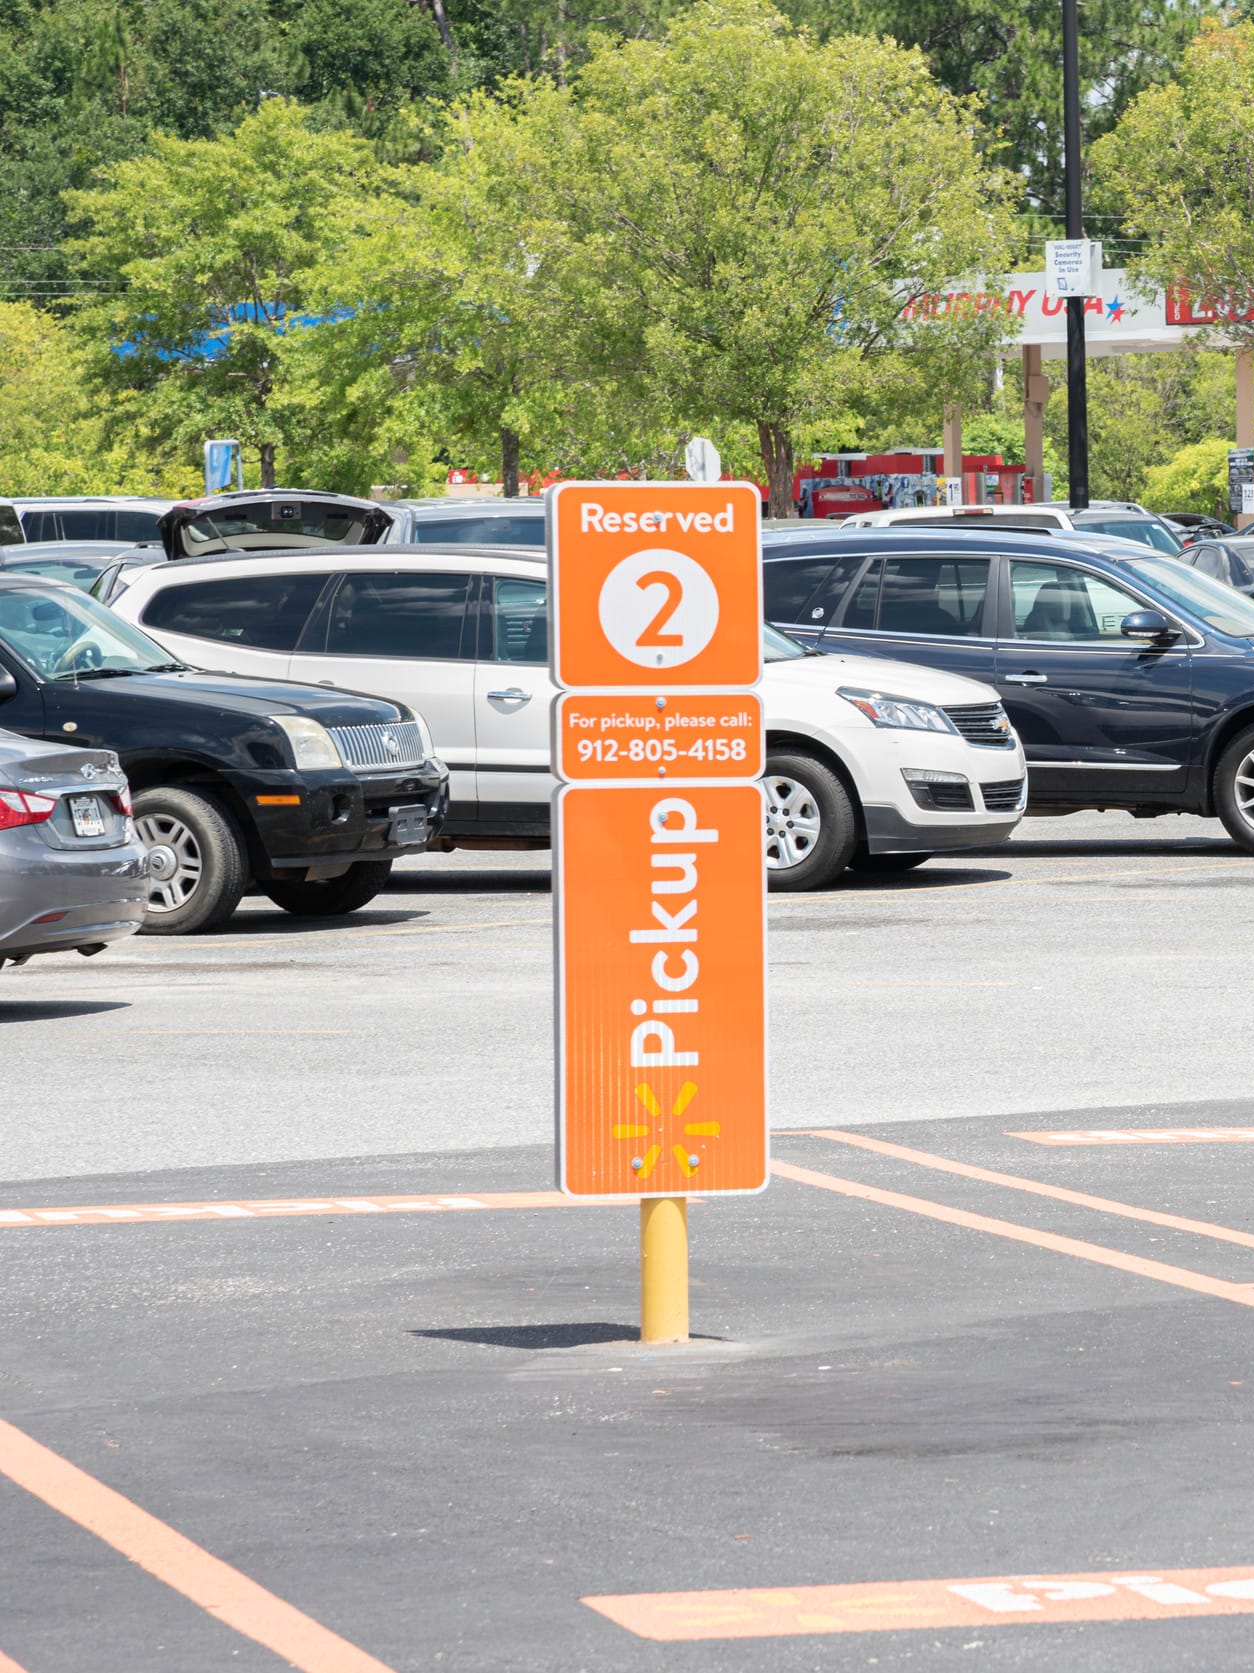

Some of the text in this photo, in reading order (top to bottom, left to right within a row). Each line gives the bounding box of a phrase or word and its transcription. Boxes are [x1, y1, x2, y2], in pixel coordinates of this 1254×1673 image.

[1055, 251, 1081, 259] Security
[581, 502, 734, 533] Reserved
[635, 570, 684, 647] 2
[569, 713, 753, 732] For pickup, please call:
[577, 738, 747, 762] 912-805-4158
[629, 797, 719, 1068] Pickup
